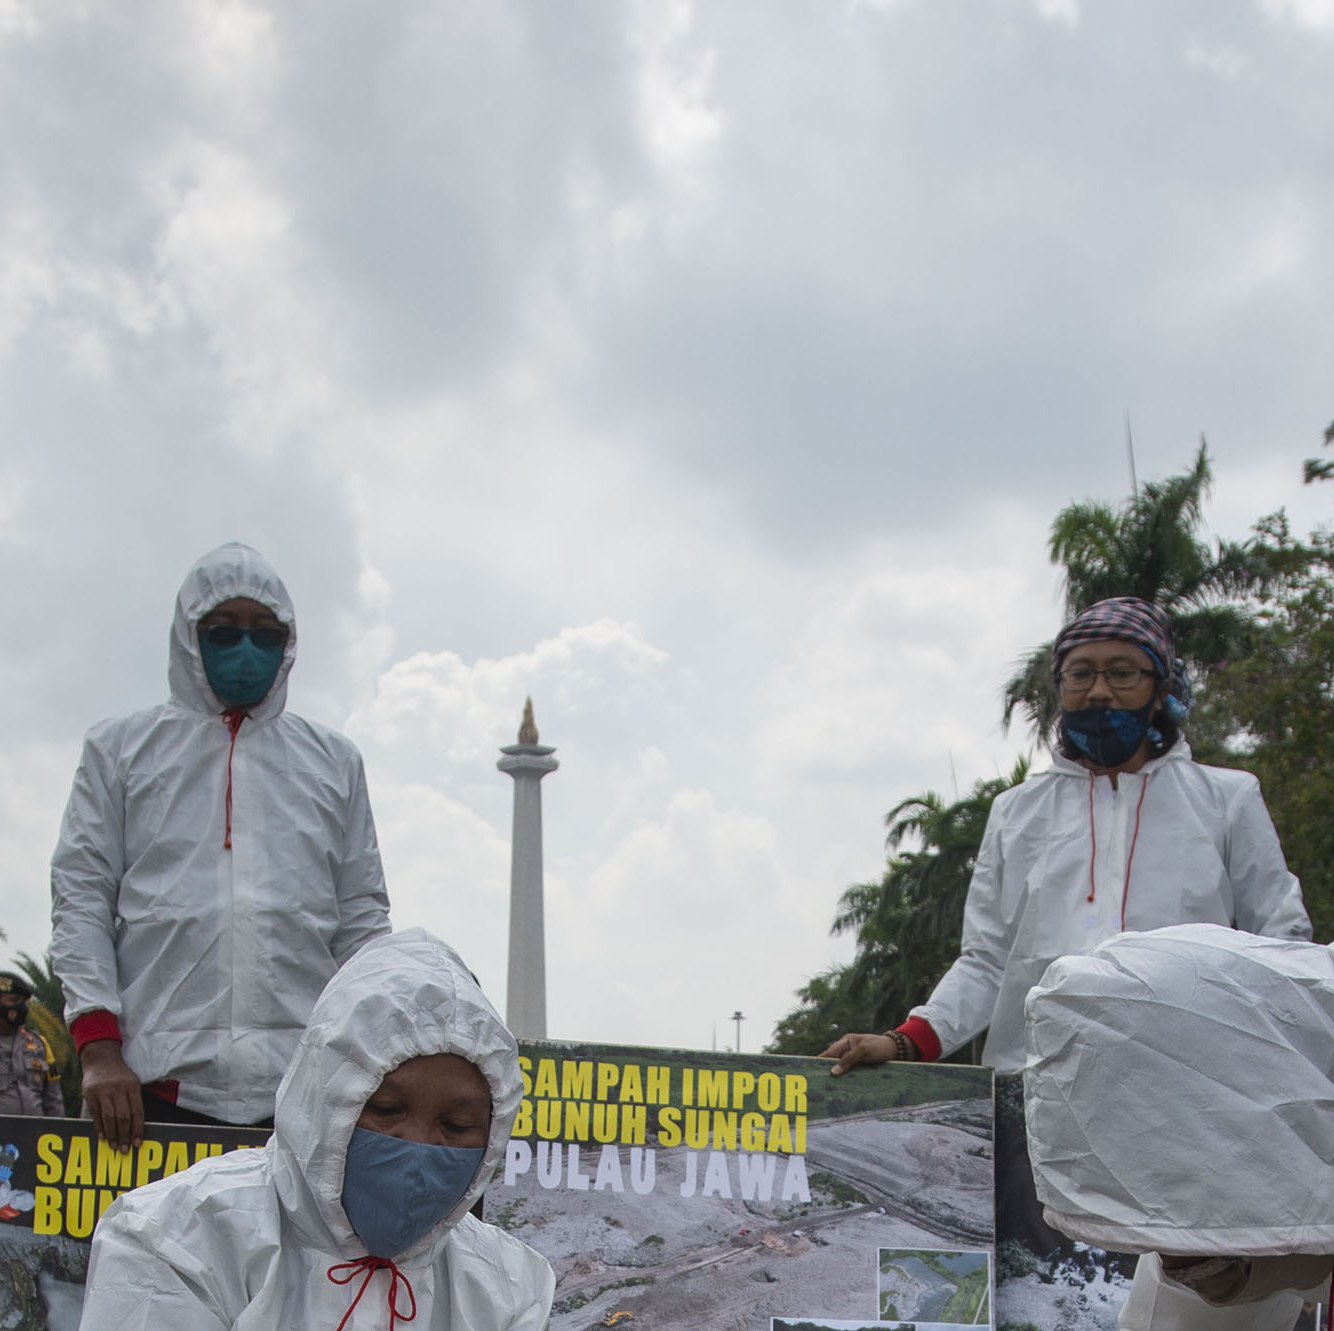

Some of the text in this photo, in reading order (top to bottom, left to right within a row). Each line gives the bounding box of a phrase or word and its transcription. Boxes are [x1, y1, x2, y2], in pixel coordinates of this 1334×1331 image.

[682, 1068, 808, 1113] IMPOR
[510, 1099, 808, 1154] BUNUH SUNGAI
[36, 1133, 222, 1187] SAMPA
[504, 1139, 812, 1203] PULAU JAWA
[33, 1186, 127, 1238] BU
